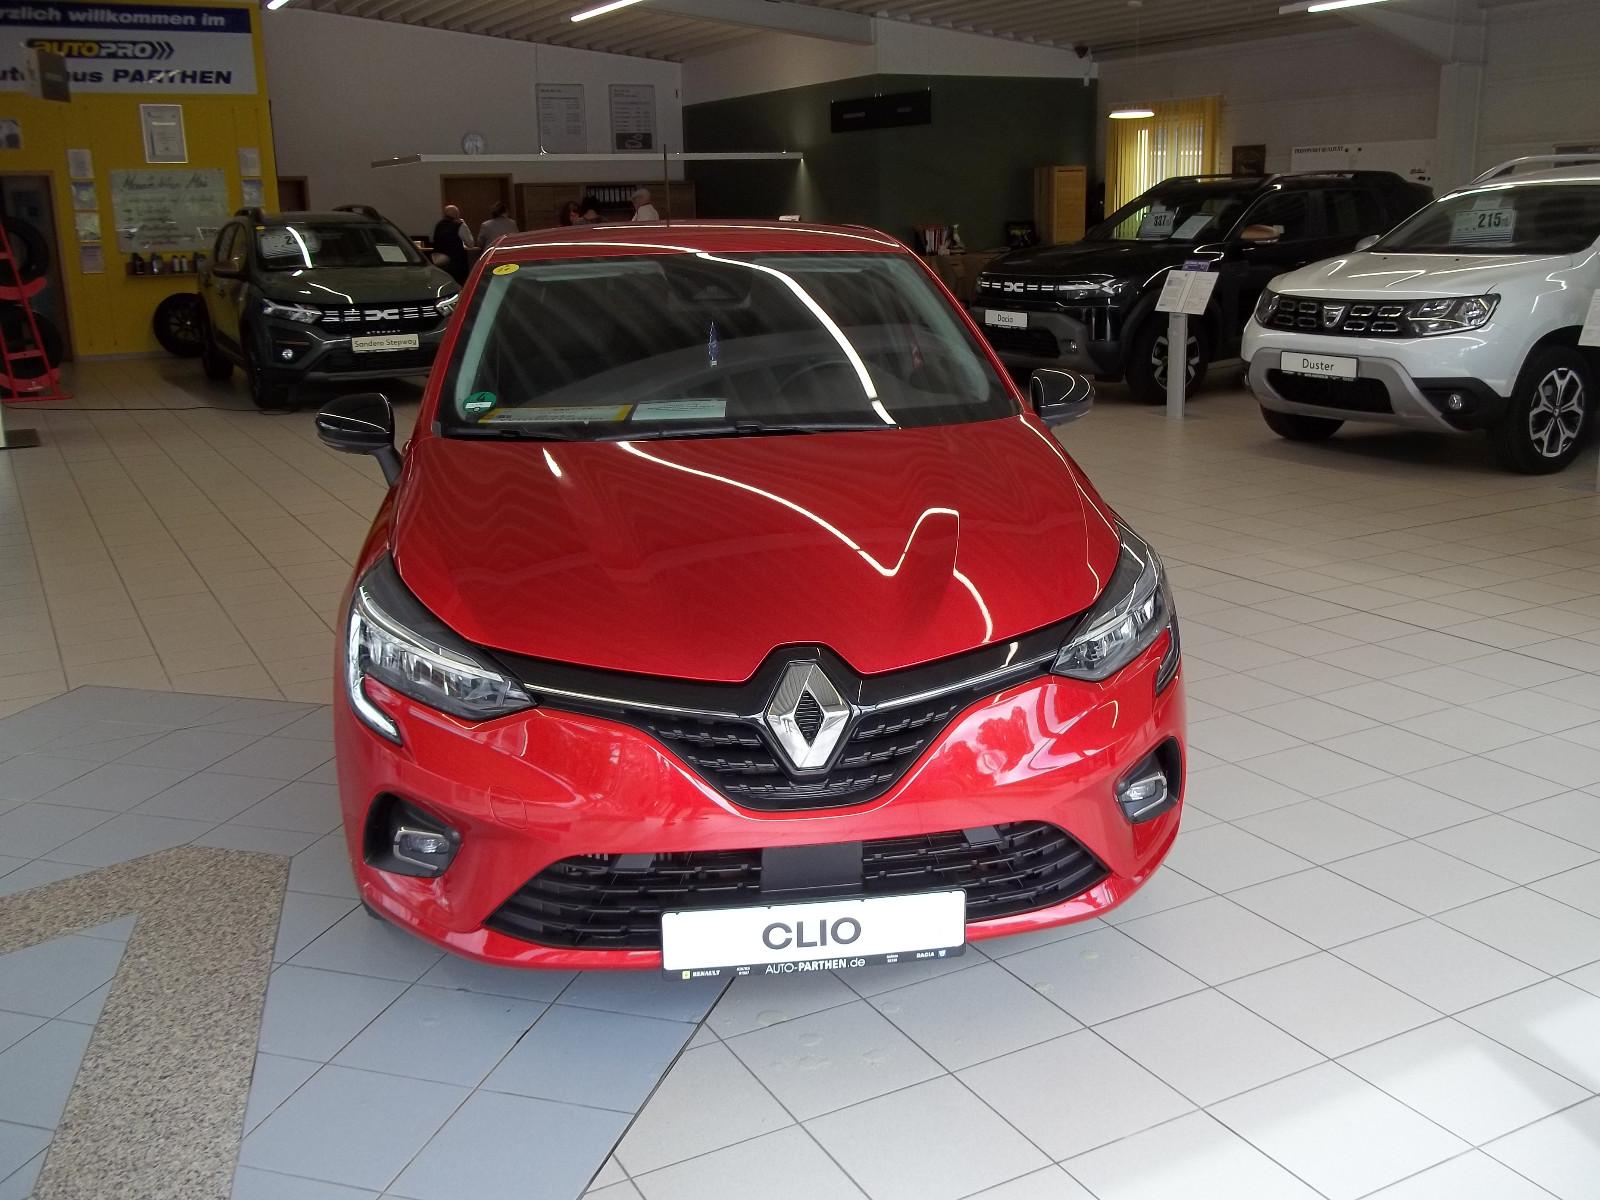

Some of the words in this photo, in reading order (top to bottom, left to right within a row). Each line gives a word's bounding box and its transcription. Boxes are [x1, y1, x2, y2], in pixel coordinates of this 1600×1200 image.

[68, 9, 195, 26] willkommen
[202, 13, 225, 27] im
[112, 69, 232, 84] PARTHEN
[1478, 212, 1502, 228] 215
[997, 314, 1014, 322] Dacia
[354, 339, 385, 348] Sandero
[386, 338, 417, 347] Stepway
[1302, 358, 1335, 371] Duster
[762, 917, 862, 950] CLIO
[916, 951, 935, 959] DACIA
[692, 969, 721, 977] RENAULT
[765, 957, 866, 975] AUTO-PARTHEN.de
